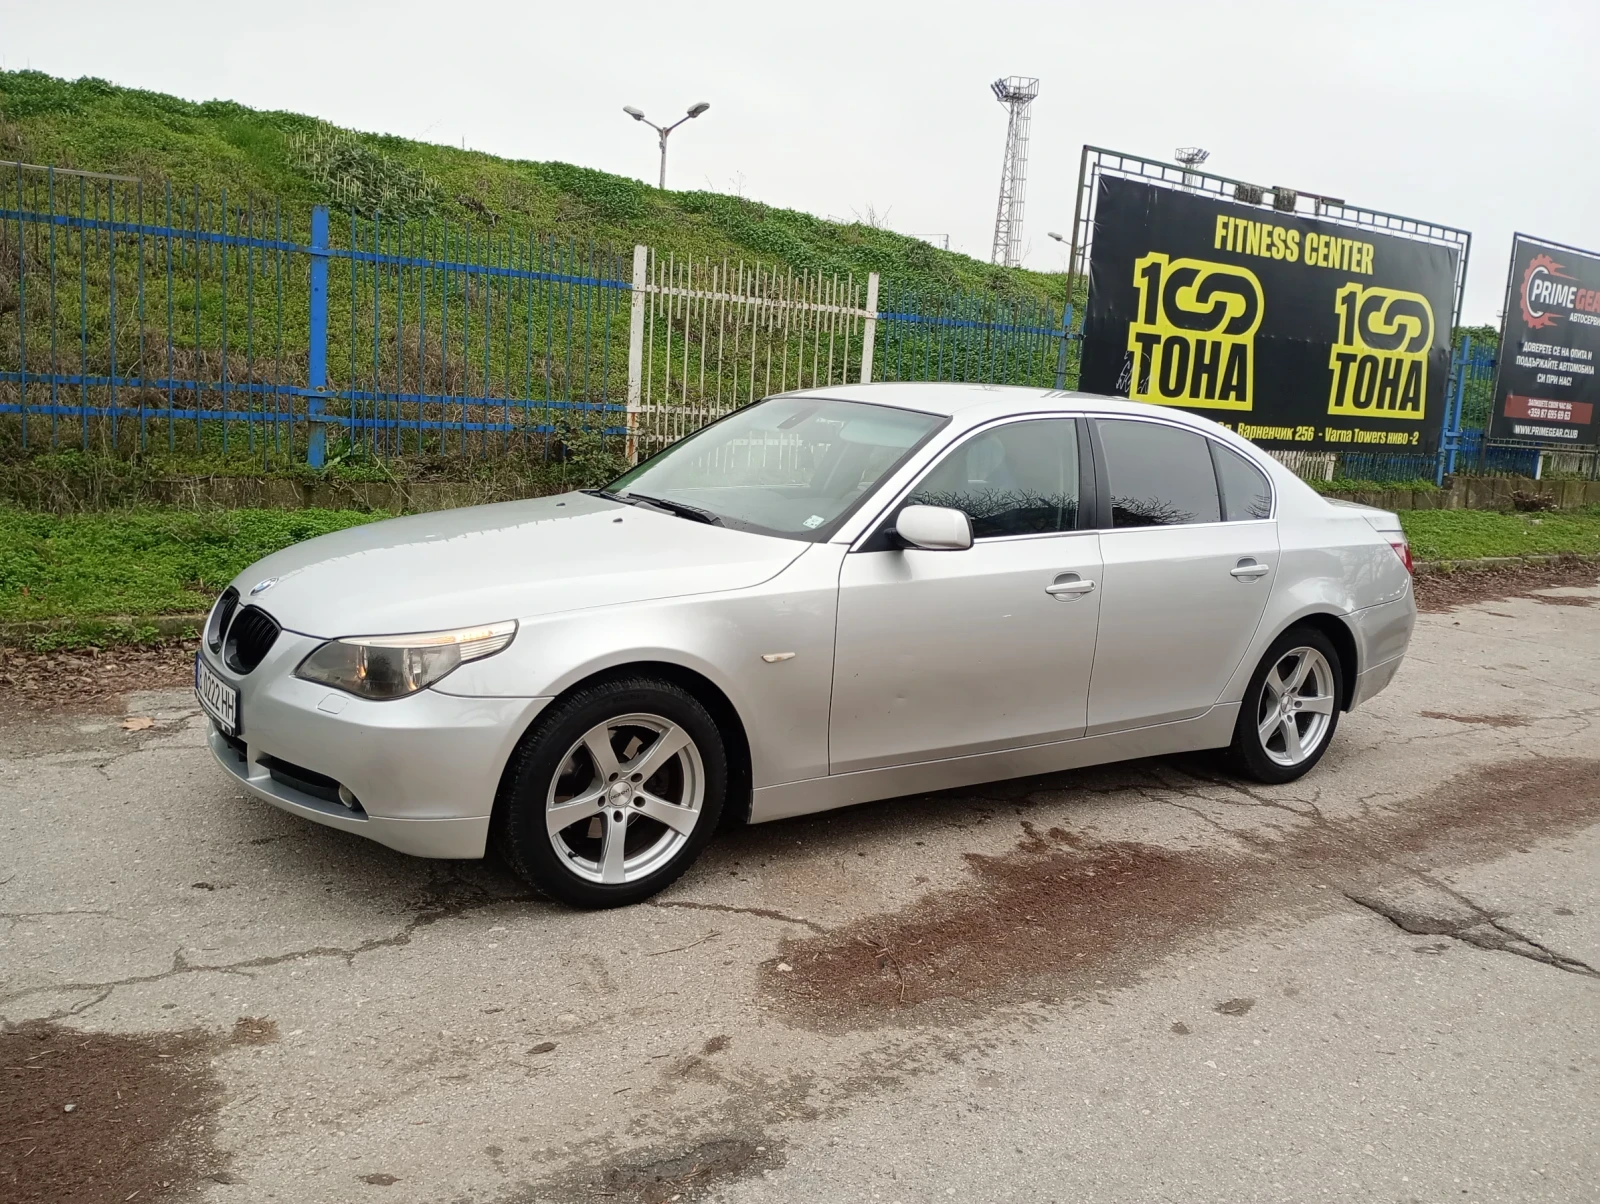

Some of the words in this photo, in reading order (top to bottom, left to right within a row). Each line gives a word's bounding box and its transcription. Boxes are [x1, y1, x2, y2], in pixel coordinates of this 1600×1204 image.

[1214, 215, 1300, 262] FITNESS
[1304, 233, 1374, 275] CENTER
[1523, 341, 1552, 355] ДОВЕРЕТЕ
[1552, 346, 1561, 356] СЕ
[1561, 347, 1569, 357] НА
[1570, 348, 1587, 360] ОПИТА
[1588, 351, 1593, 360] И
[1135, 333, 1247, 402] ТОНА
[1516, 355, 1558, 370] ПОДДЪРЖАЙТЕ
[1558, 361, 1594, 375] АВТОМОБИЛА
[1335, 353, 1423, 412] ТОНА
[1537, 373, 1545, 383] СИ
[1546, 374, 1558, 385] ПРИ
[1558, 376, 1573, 386] НАС!
[1528, 408, 1540, 418] +359
[1238, 422, 1294, 441] Варненчик
[1295, 426, 1315, 442] 256
[1325, 427, 1352, 443] Varna
[1353, 428, 1386, 444] Towers
[1387, 433, 1409, 444] ниво
[1409, 431, 1420, 445] -2
[1514, 424, 1579, 439] WWW.PRIMEGEAR.CLUB
[203, 671, 220, 712] 0222
[221, 686, 234, 723] HH
